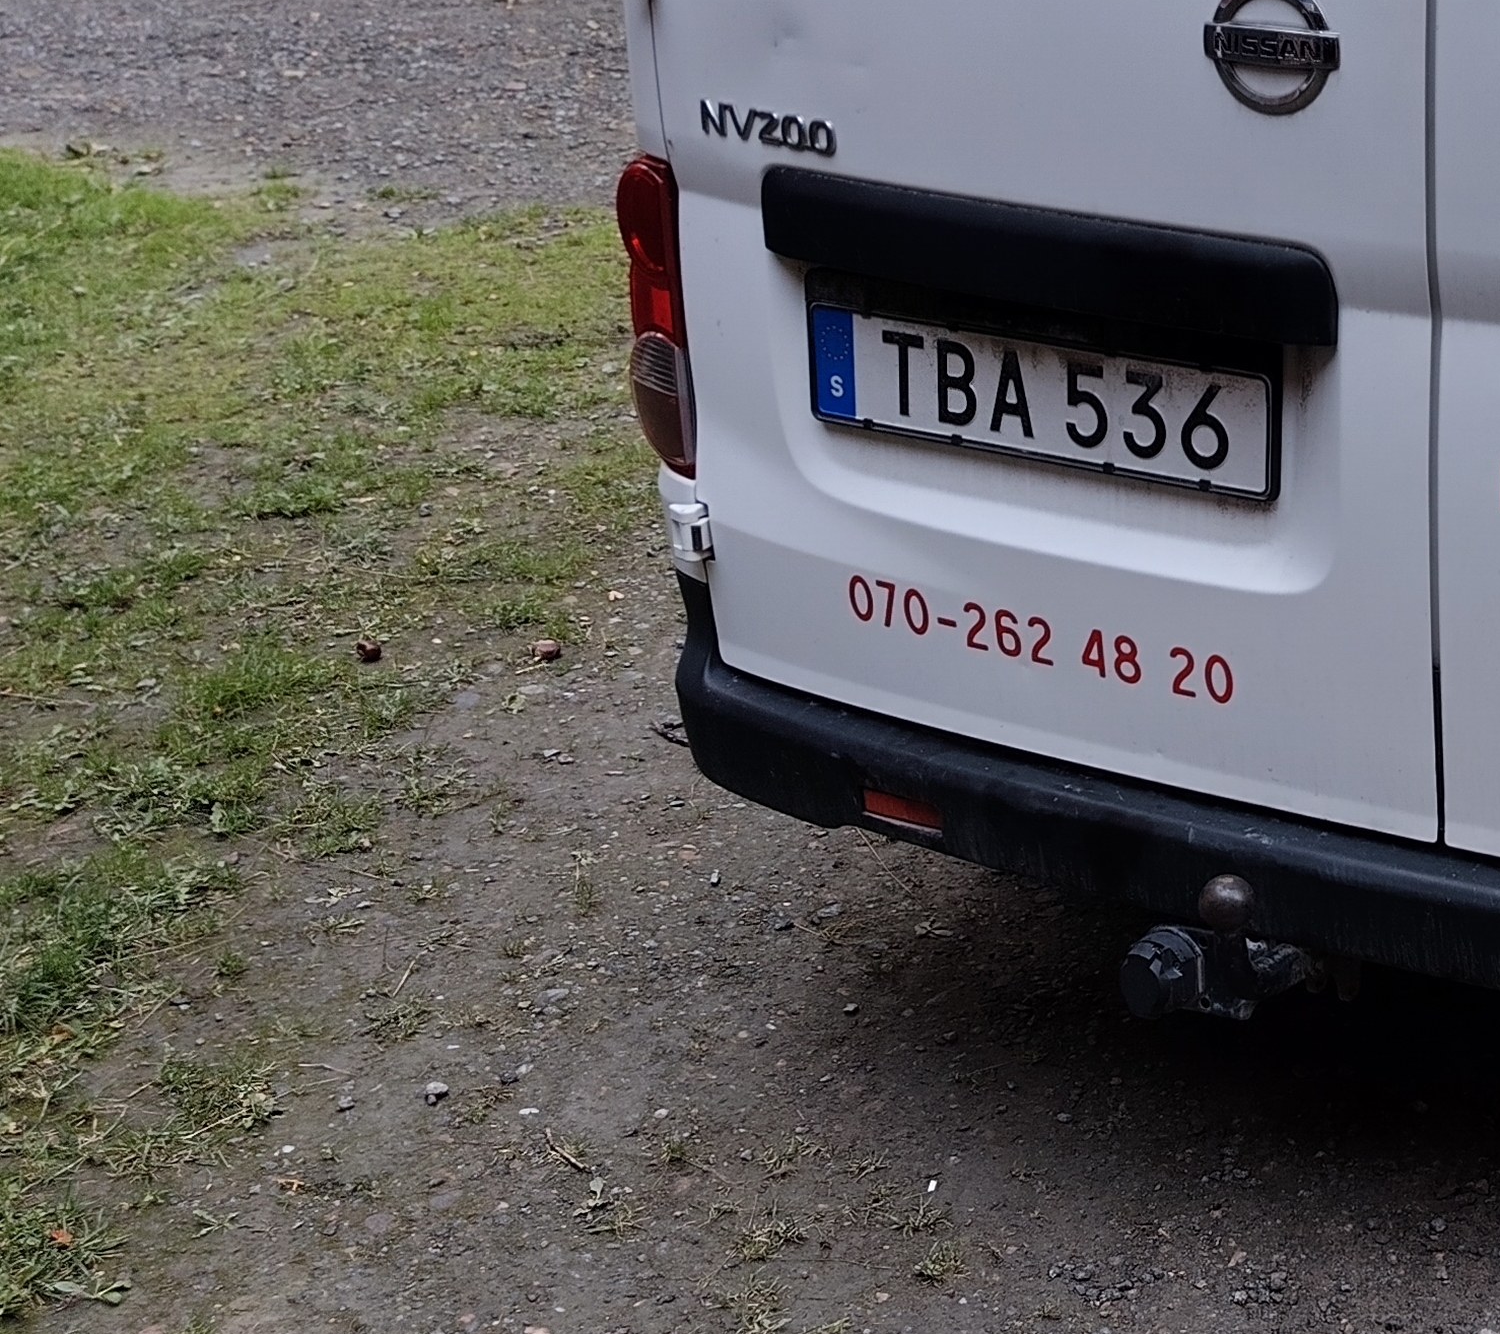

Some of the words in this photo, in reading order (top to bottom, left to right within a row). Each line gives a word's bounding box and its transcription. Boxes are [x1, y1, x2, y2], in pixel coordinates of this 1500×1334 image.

[1213, 29, 1322, 63] NISSAN
[700, 99, 837, 158] NV200
[829, 375, 844, 398] S
[881, 329, 1034, 439] TBA
[1065, 361, 1230, 471] 536
[848, 574, 1055, 667] 070-262
[1081, 629, 1143, 685] 48
[1171, 646, 1236, 705] 20
